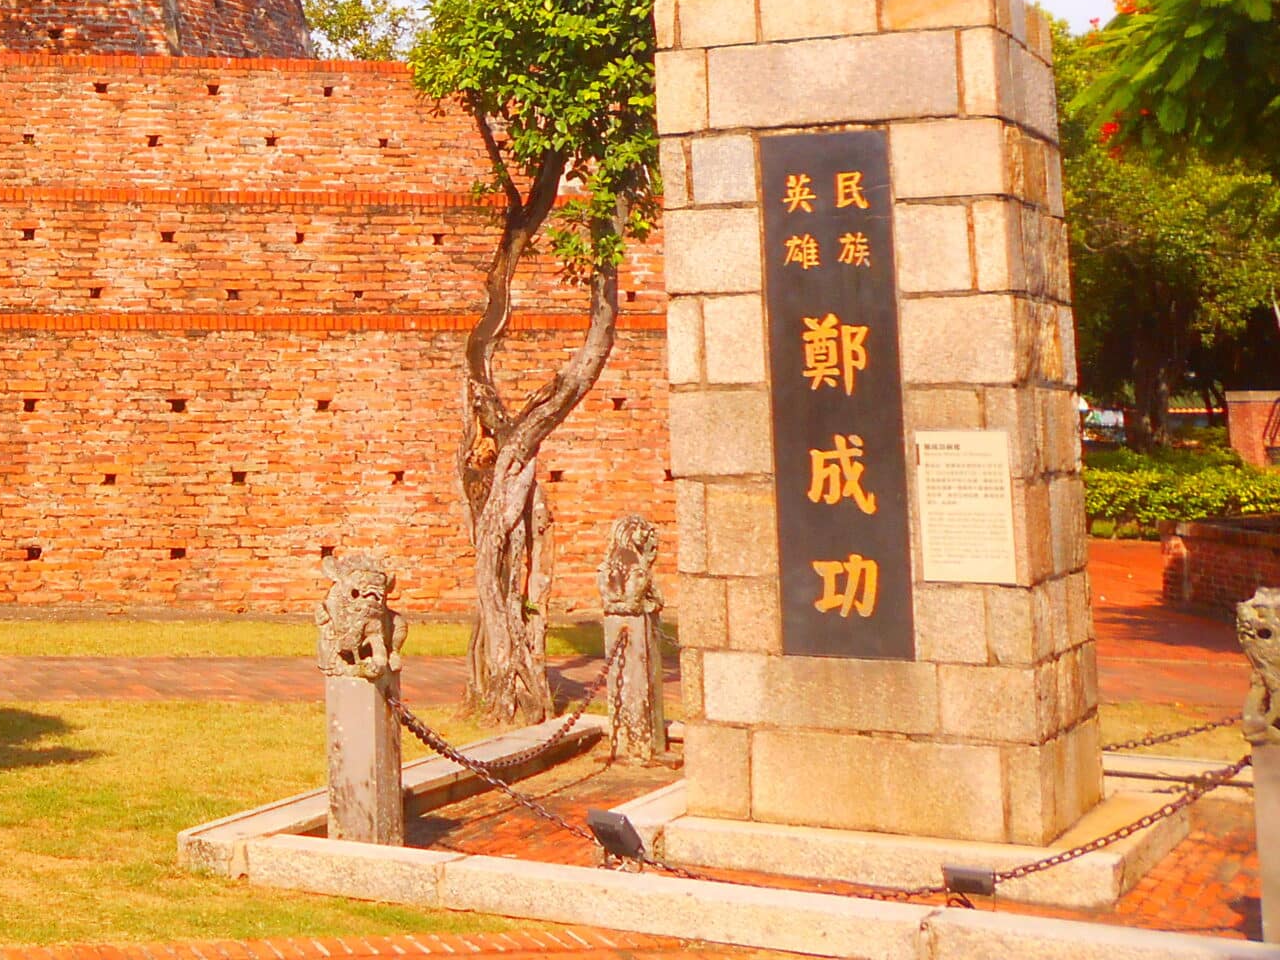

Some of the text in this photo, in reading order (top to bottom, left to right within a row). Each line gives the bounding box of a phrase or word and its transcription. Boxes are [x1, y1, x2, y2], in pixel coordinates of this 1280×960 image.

[781, 173, 821, 270] 英雄
[833, 170, 871, 268] 民族
[801, 312, 880, 618] 鄭成功
